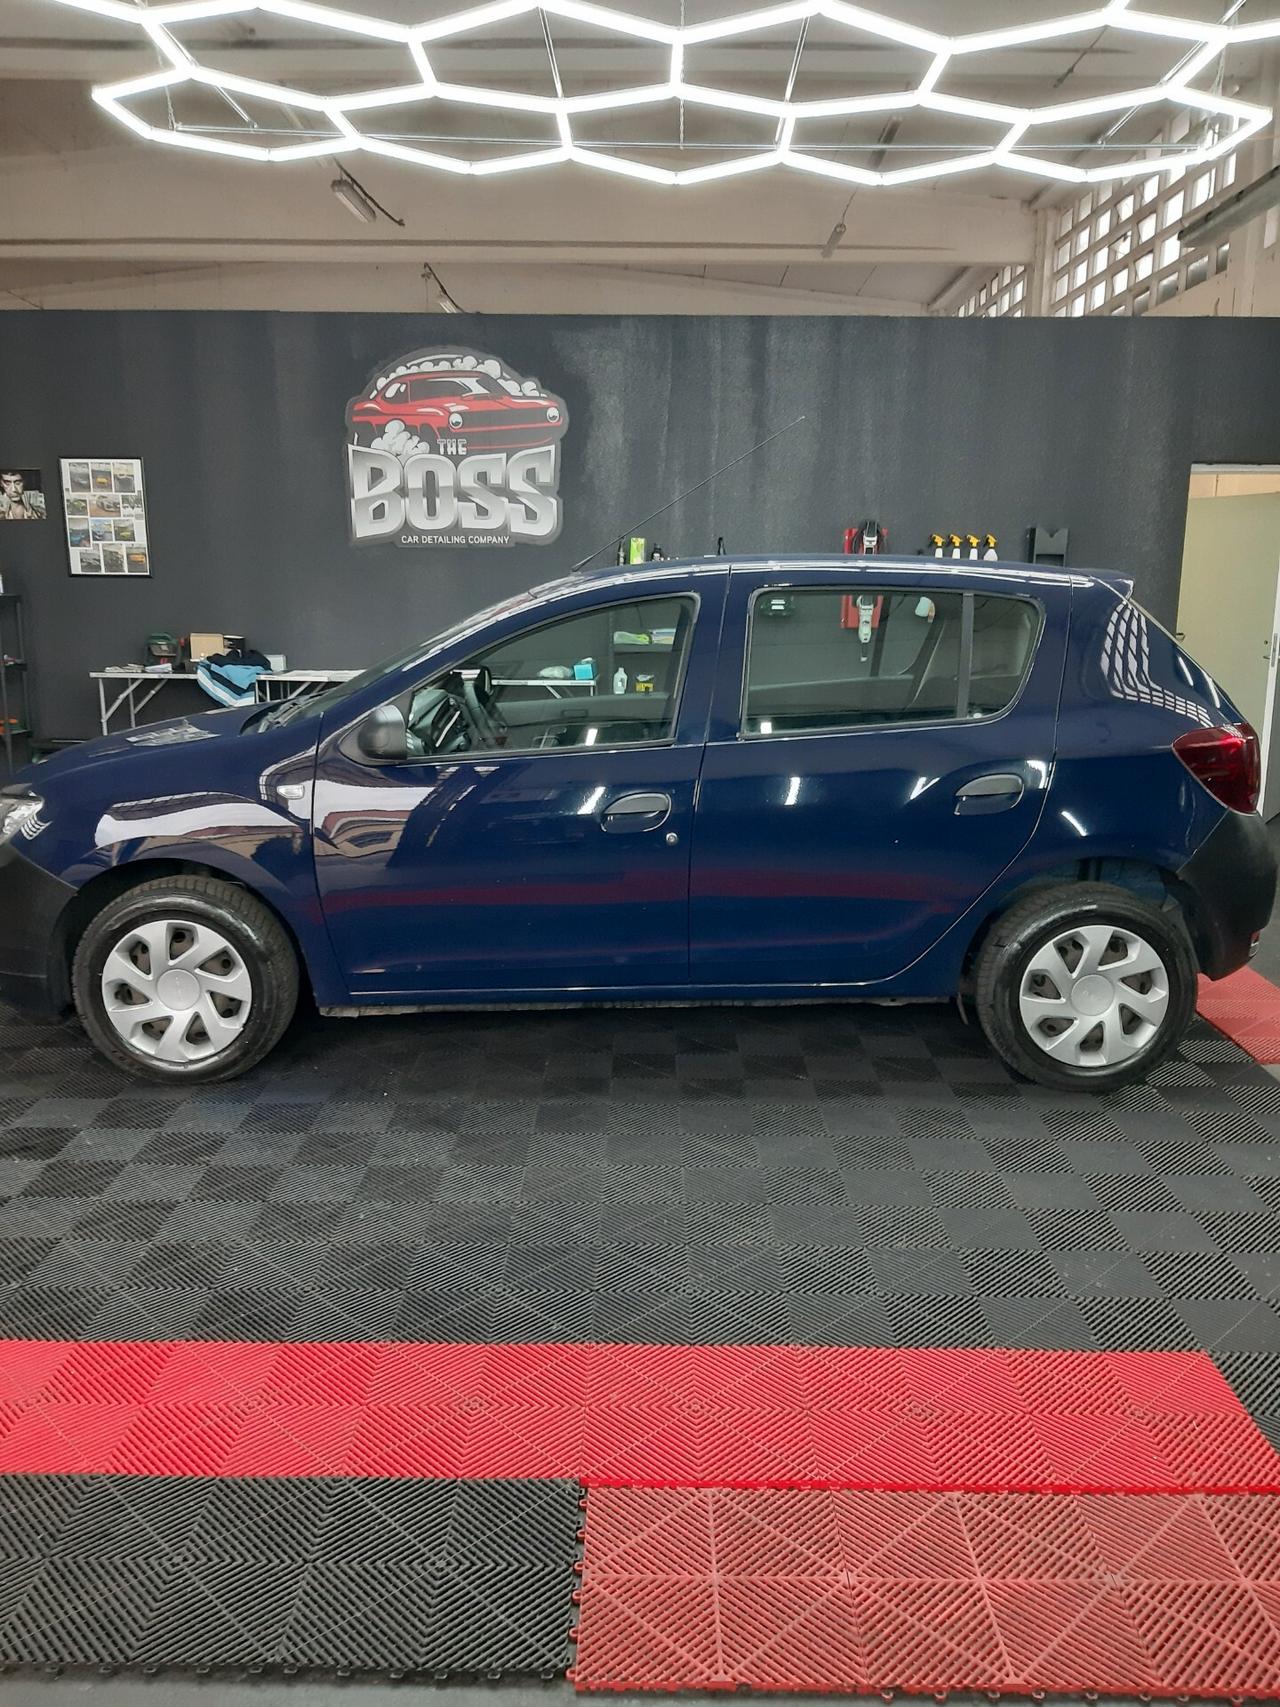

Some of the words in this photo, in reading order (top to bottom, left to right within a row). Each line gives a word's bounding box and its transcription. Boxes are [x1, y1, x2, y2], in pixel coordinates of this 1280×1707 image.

[436, 438, 467, 455] THE
[348, 443, 558, 538] BOSS
[401, 535, 419, 544] CAR
[421, 535, 466, 544] DETAILING
[468, 535, 510, 544] COMPANY
